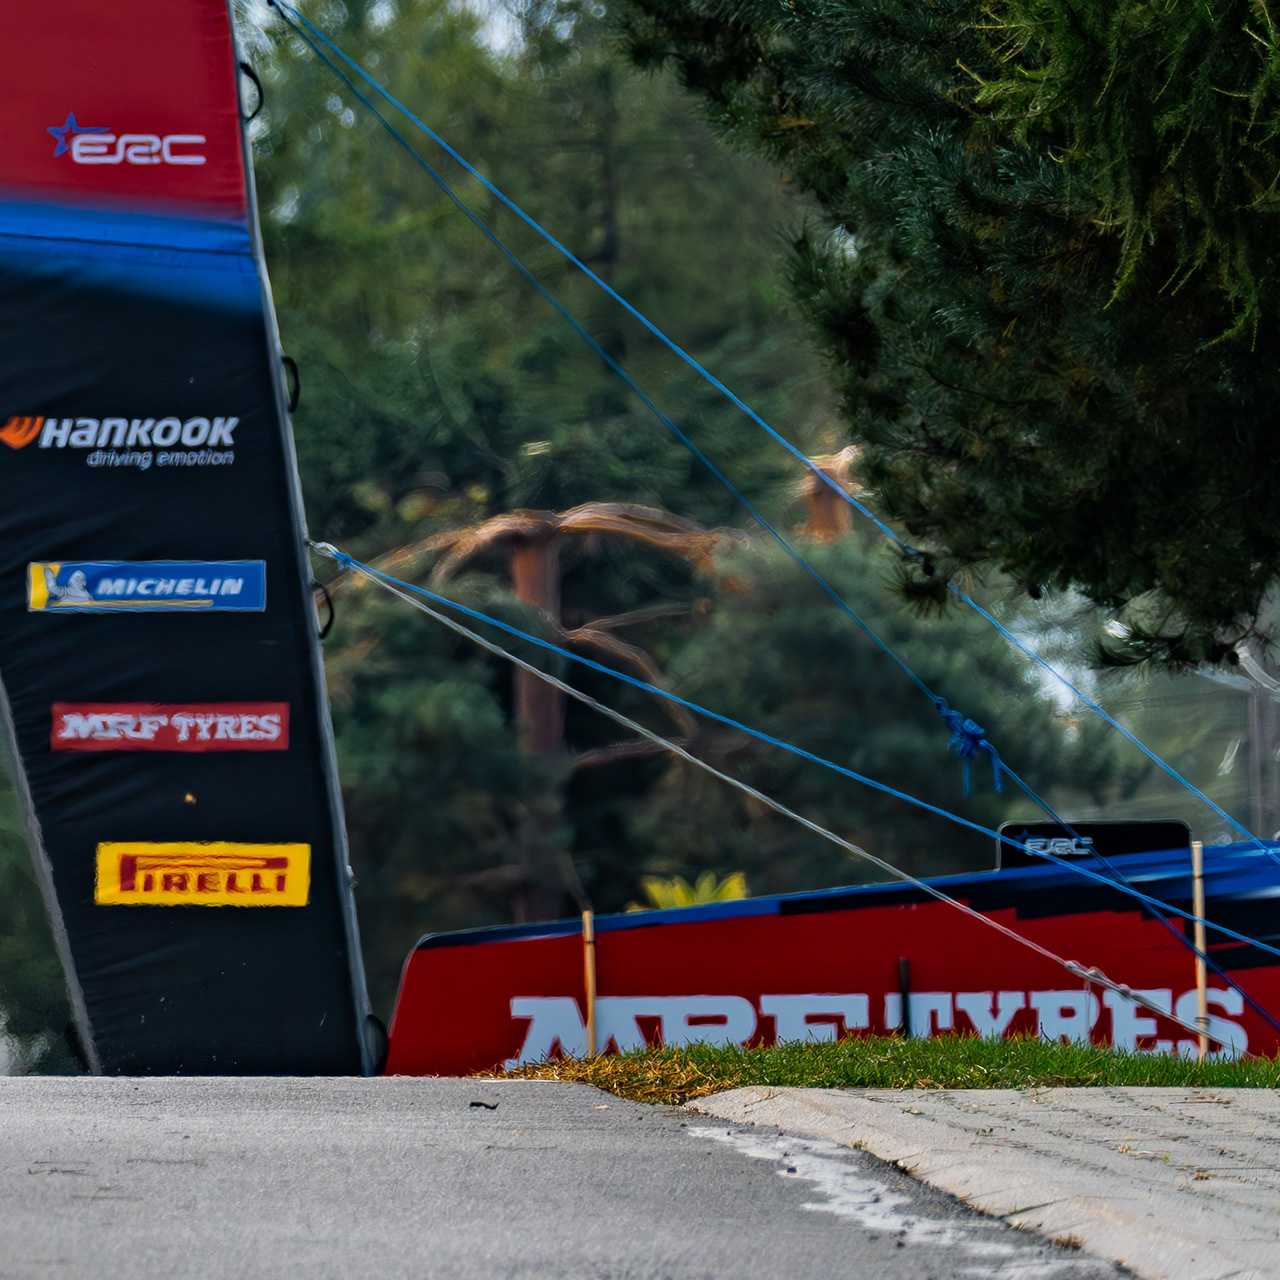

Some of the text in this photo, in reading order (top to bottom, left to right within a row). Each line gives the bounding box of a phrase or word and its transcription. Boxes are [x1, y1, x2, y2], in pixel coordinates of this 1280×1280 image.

[71, 134, 207, 165] ERC
[97, 577, 244, 598] MICHELIN
[58, 713, 282, 740] MRF TYRES
[120, 854, 288, 892] PIRELLI
